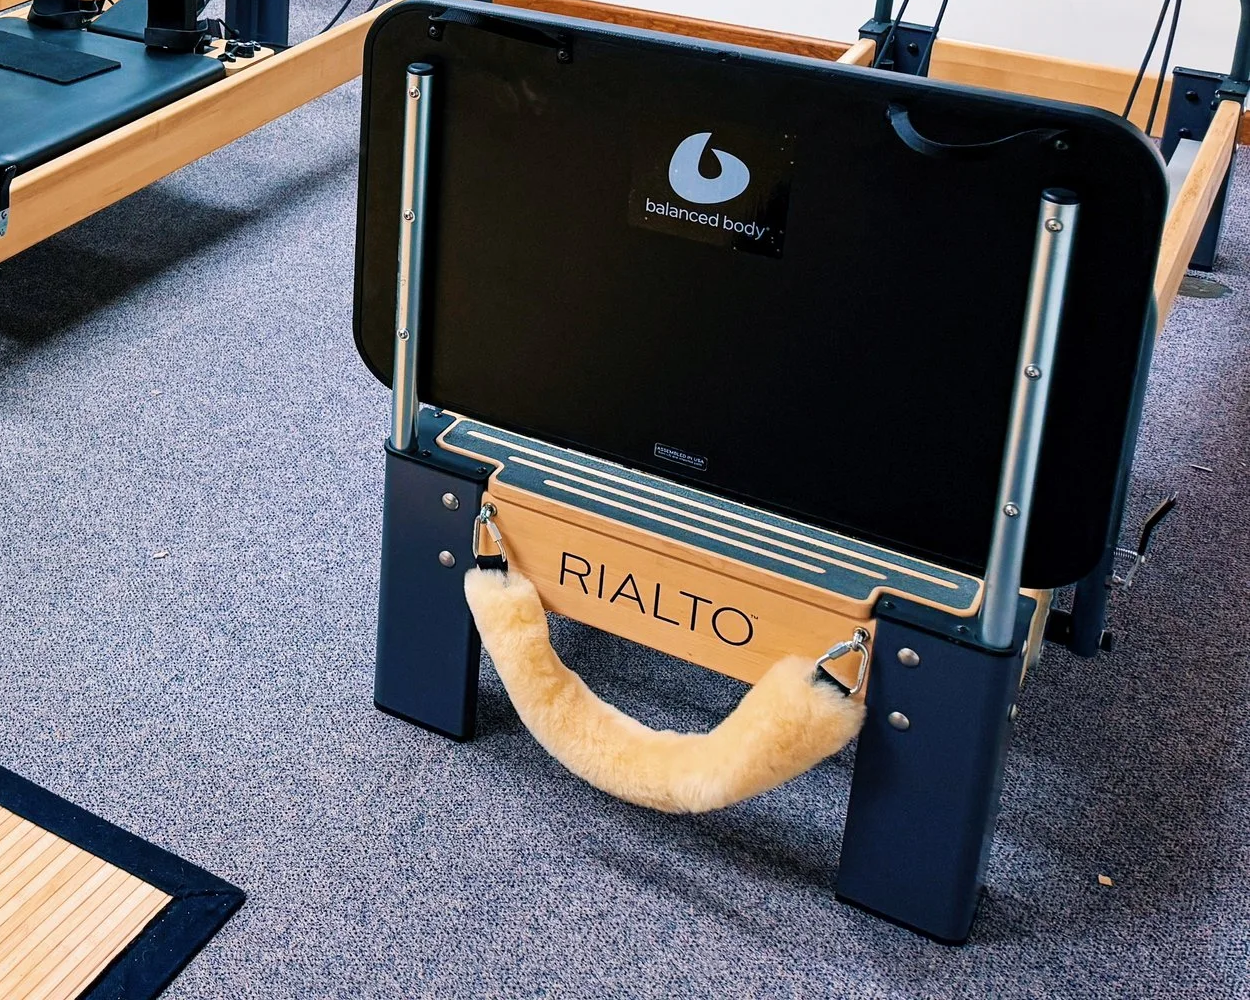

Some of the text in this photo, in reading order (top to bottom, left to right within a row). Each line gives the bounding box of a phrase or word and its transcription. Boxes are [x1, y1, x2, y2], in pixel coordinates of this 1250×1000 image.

[645, 197, 766, 241] balanced body
[657, 446, 686, 458] ASSEMBLED
[559, 551, 755, 647] RIALTO
